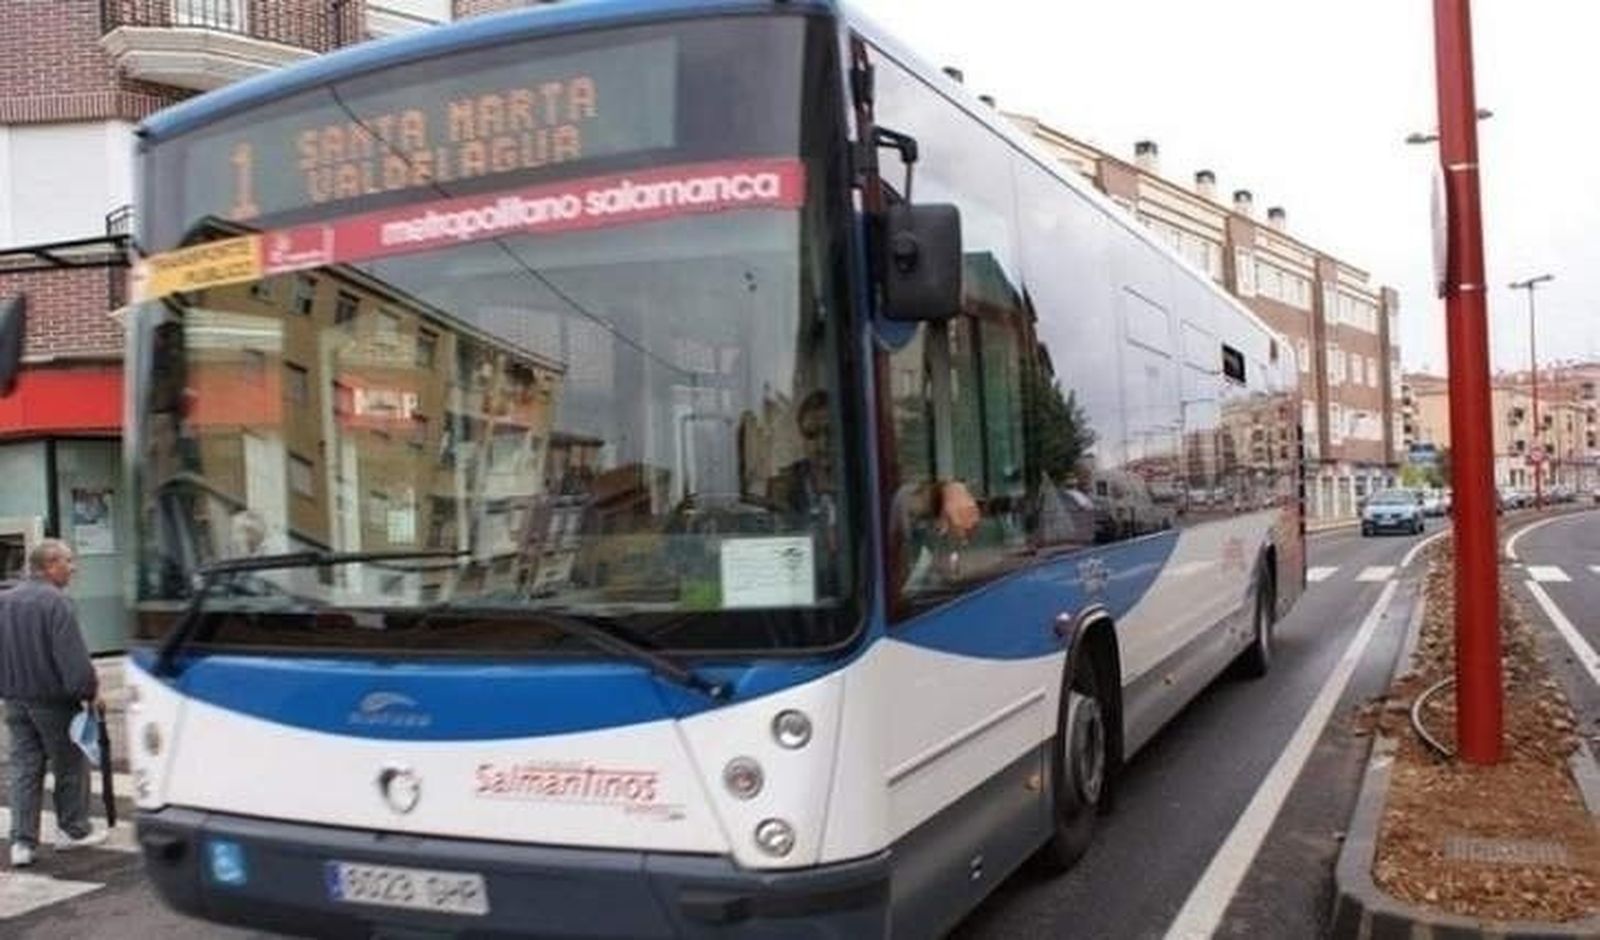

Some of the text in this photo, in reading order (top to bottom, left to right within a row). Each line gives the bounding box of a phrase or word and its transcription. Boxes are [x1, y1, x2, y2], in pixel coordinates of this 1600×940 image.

[297, 76, 596, 173] SANTA MARTA
[305, 123, 581, 202] VALDELAGUA
[229, 142, 260, 221] 1
[381, 171, 781, 246] metropolitano salamanca
